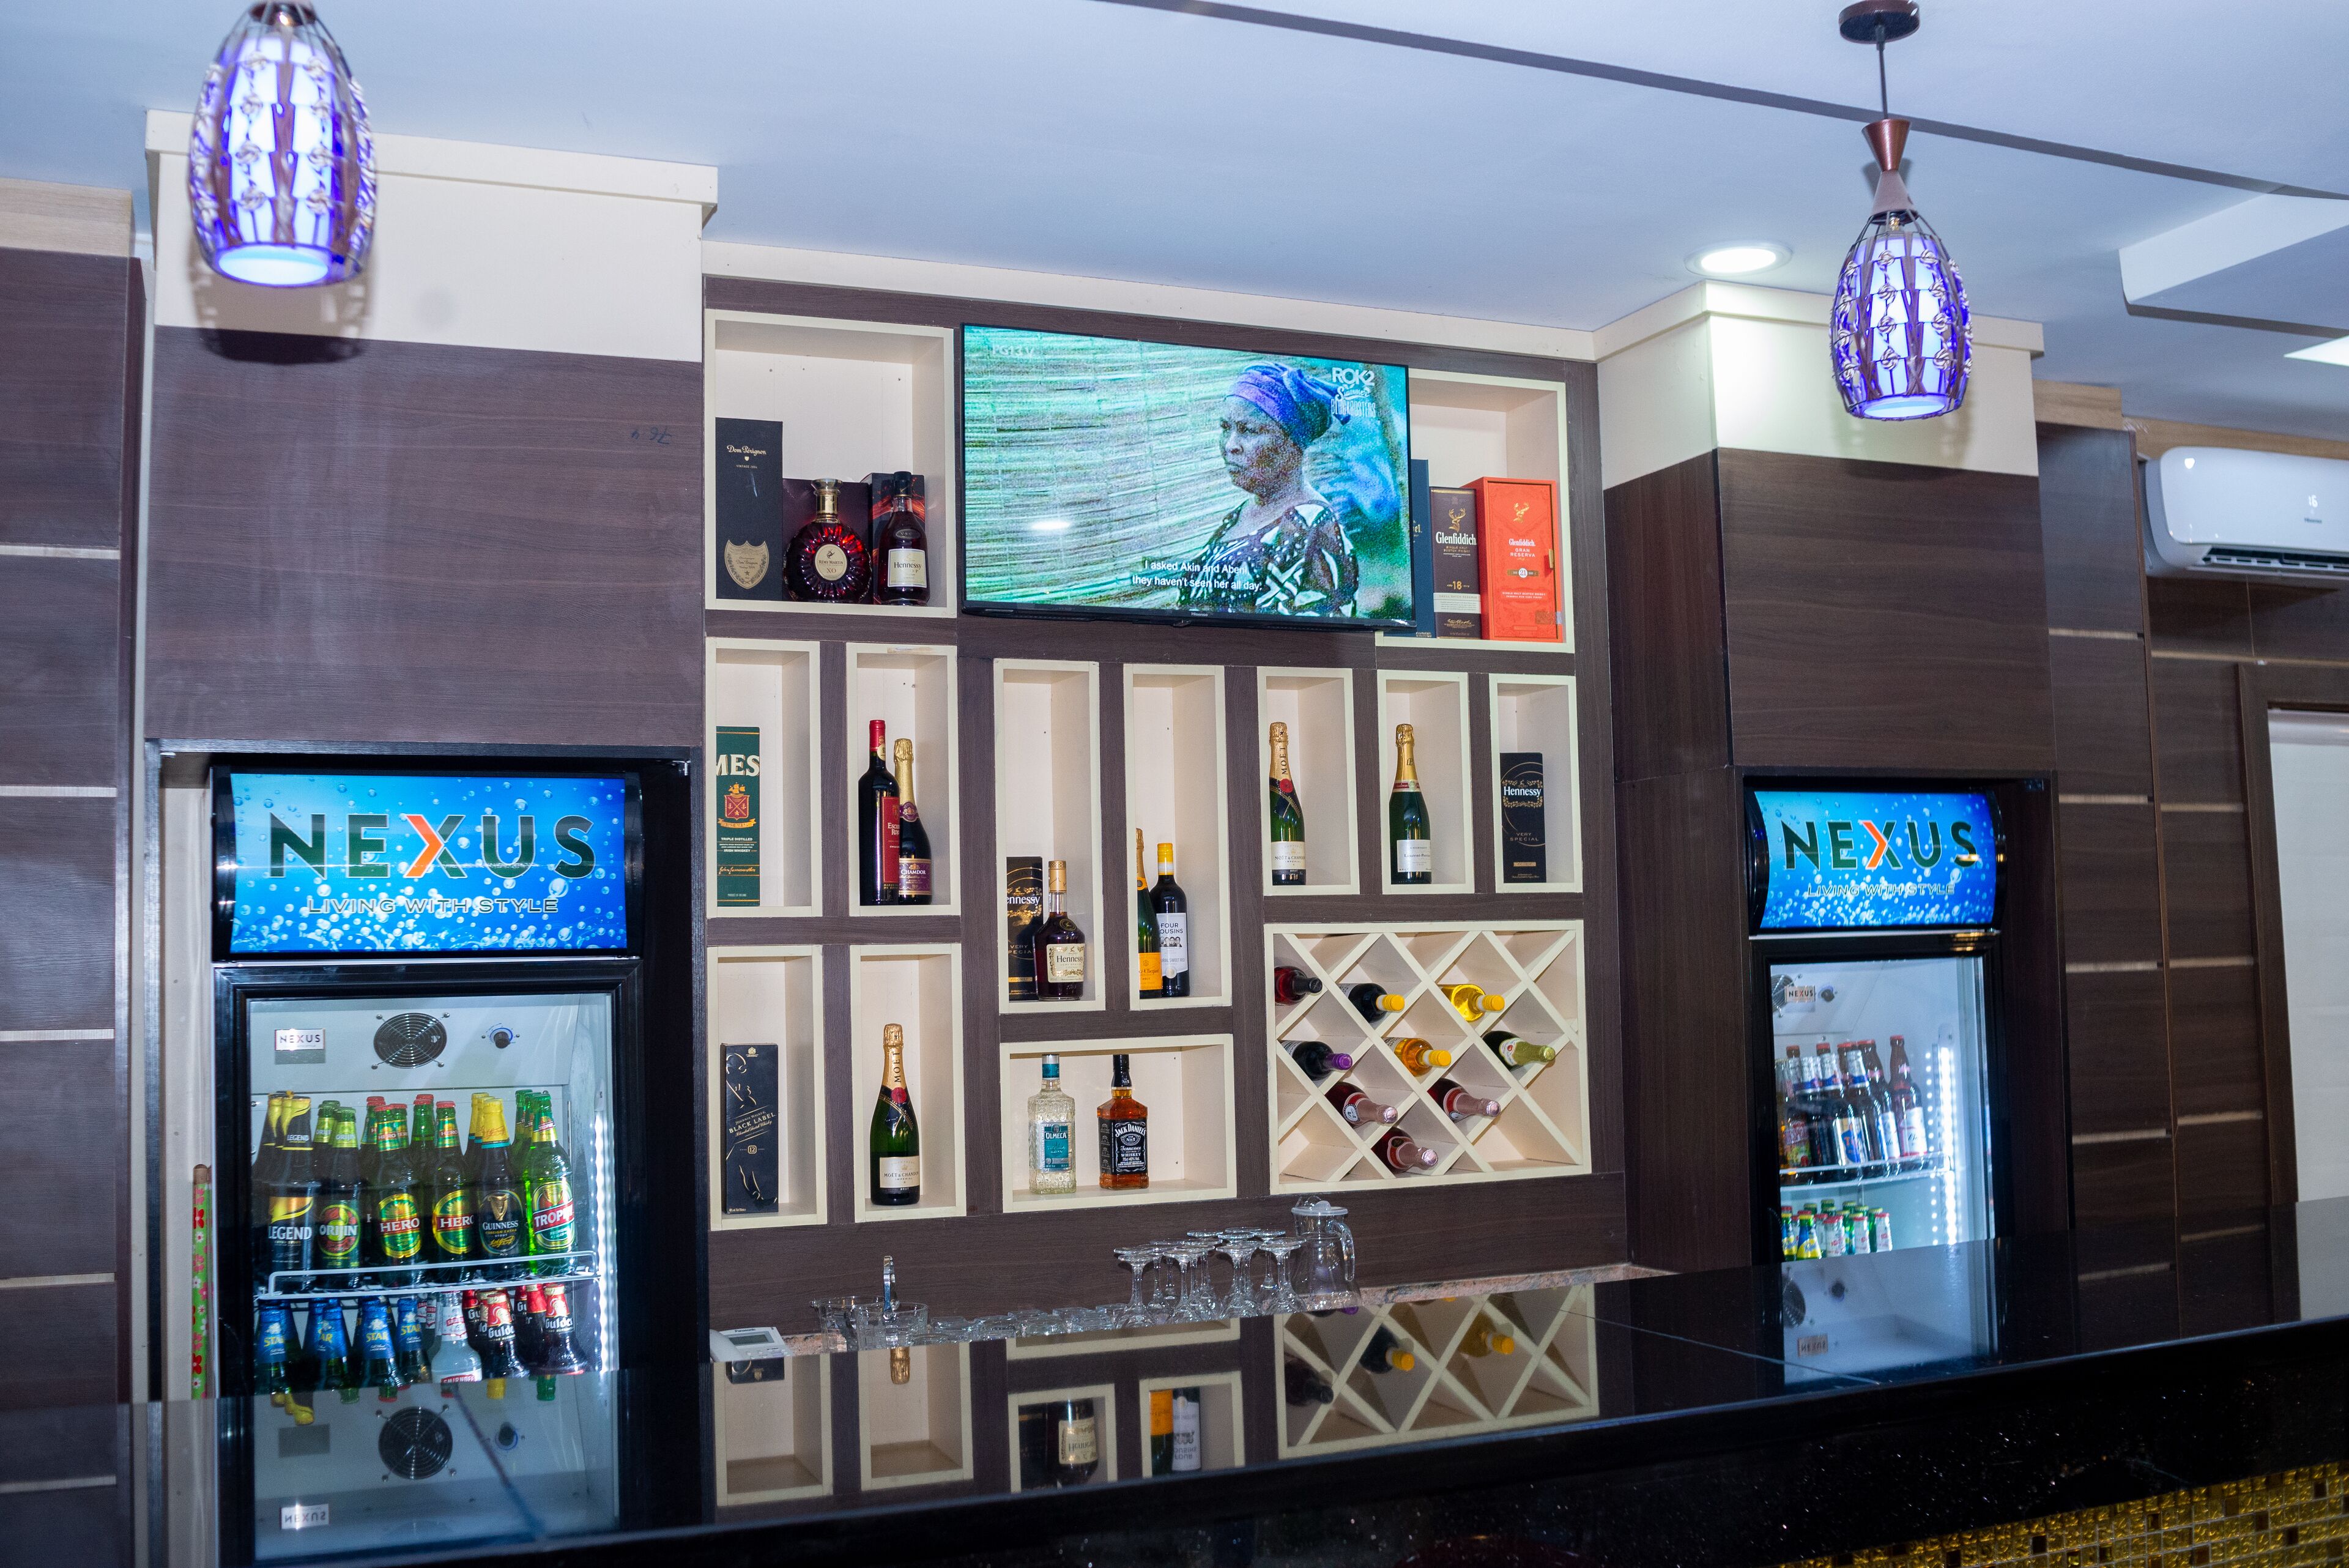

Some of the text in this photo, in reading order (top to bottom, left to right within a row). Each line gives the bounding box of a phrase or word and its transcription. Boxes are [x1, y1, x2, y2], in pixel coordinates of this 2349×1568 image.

[1332, 368, 1375, 386] ROK2
[742, 445, 766, 456] Pérignon
[1436, 532, 1476, 545] Glenfiddich
[1180, 562, 1200, 572] Akin
[1203, 565, 1220, 573] and
[1132, 575, 1152, 586] they
[1154, 576, 1187, 586] haven't
[1214, 579, 1228, 588] her
[1231, 581, 1241, 589] all
[1452, 581, 1462, 590] 18
[1504, 786, 1542, 797] Hennessy
[269, 812, 596, 879] NEXUS
[1781, 820, 1978, 870] NEXUS
[1808, 883, 1955, 897] LIVING WITH STYLE
[308, 898, 558, 913] LIVING WITH STYLE
[1007, 895, 1041, 905] ennessy
[280, 1035, 320, 1043] NEXUS
[729, 1121, 751, 1133] BLACK
[1115, 1126, 1127, 1137] JACK
[534, 1204, 573, 1228] TROP
[319, 1224, 358, 1238] ORIJIN
[380, 1218, 420, 1233] HERO
[482, 1220, 519, 1230] GUINNESS
[268, 1226, 313, 1240] LEGEND
[545, 1317, 573, 1329] Gulde
[488, 1325, 514, 1339] Gulde
